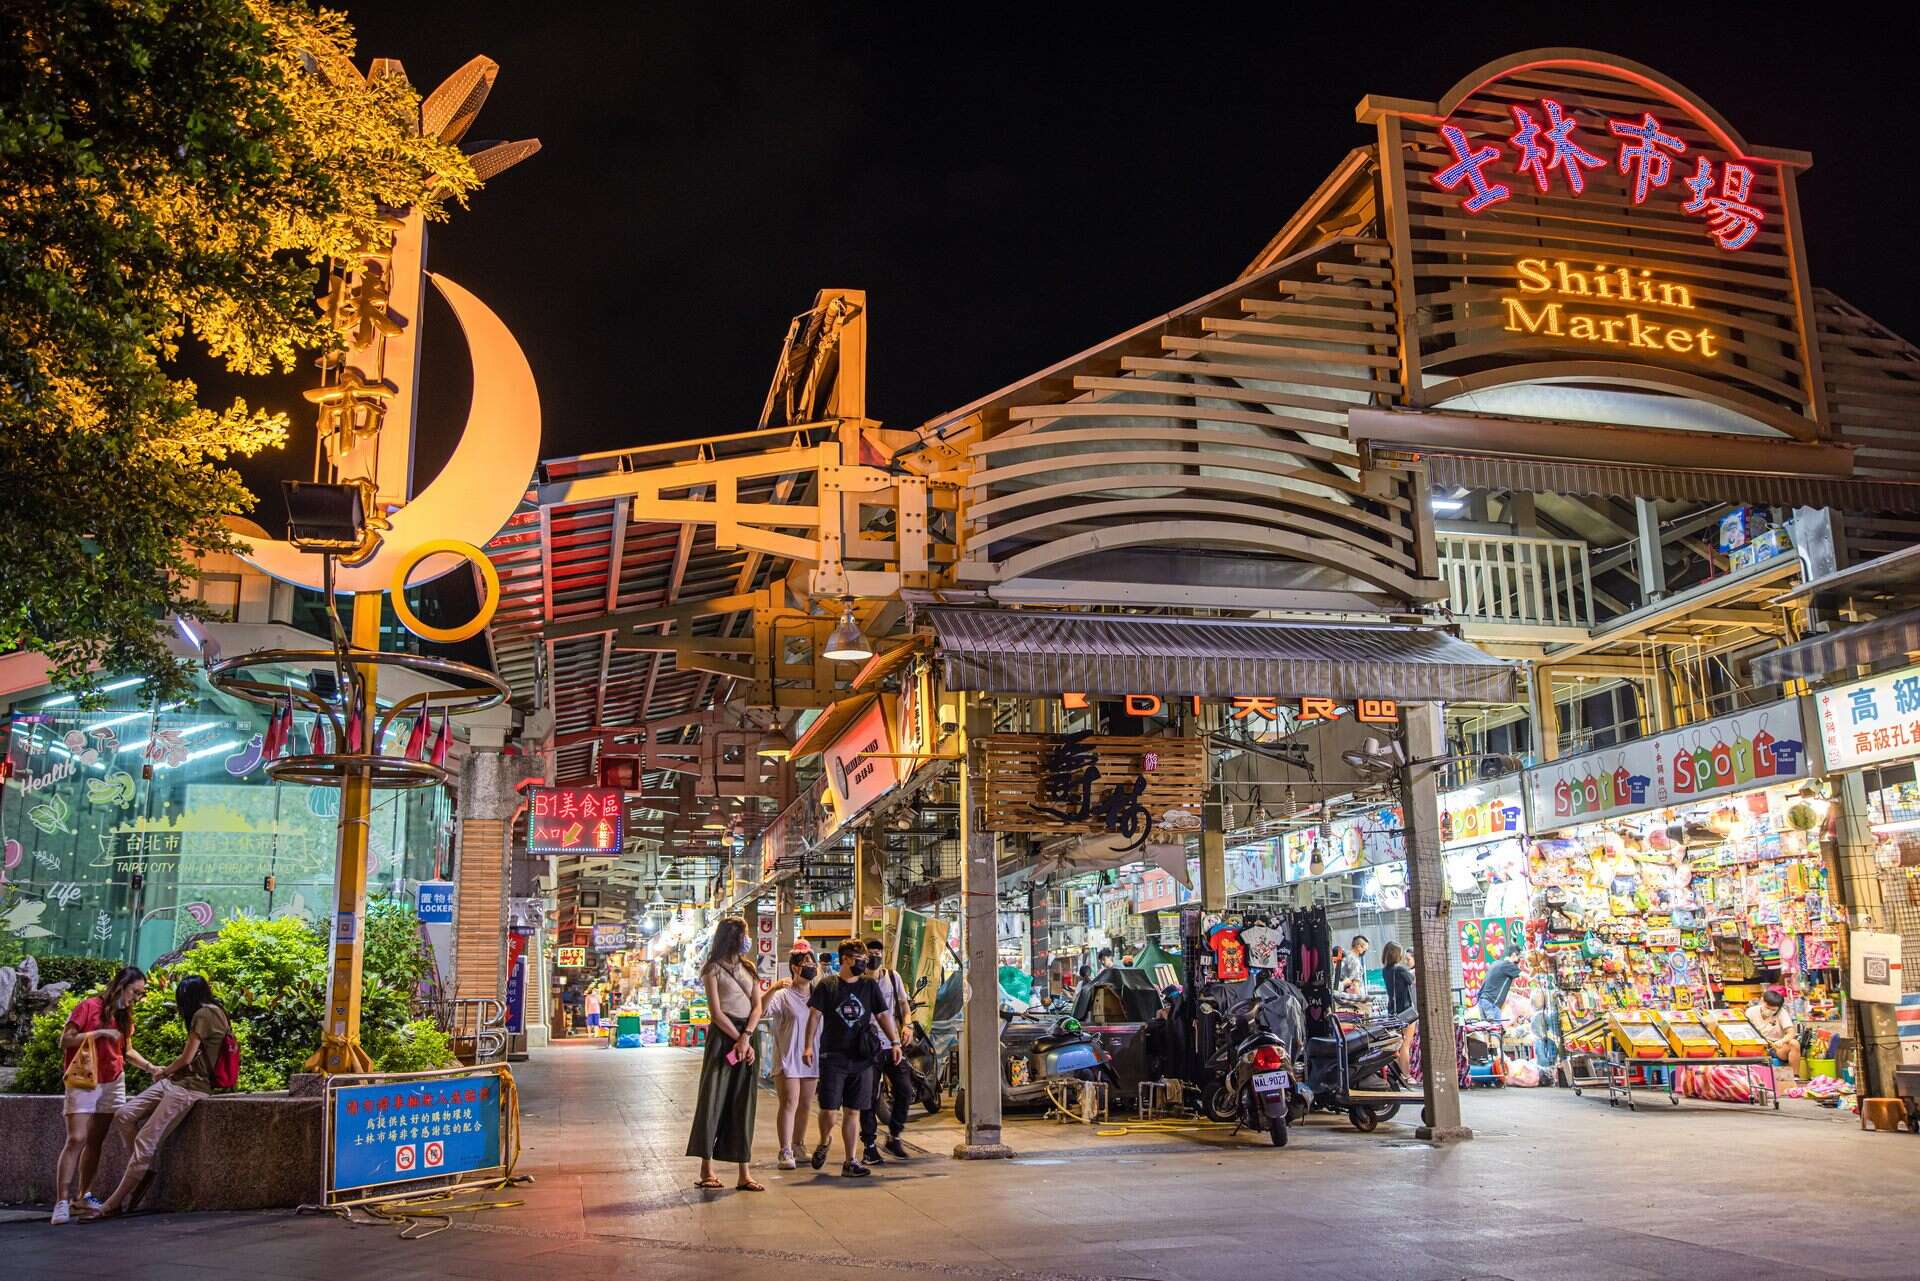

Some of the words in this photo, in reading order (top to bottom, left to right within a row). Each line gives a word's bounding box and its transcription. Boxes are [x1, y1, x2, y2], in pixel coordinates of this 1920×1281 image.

[1431, 98, 1766, 252] 士林市場
[1515, 258, 1697, 310] Shilin
[1502, 296, 1719, 358] Market
[20, 759, 77, 797] Health
[1676, 742, 1770, 791] Sport
[535, 793, 619, 818] B1美食區
[1557, 775, 1628, 815] Sport
[534, 825, 560, 840] 入口
[117, 861, 147, 874] TAIPEI
[150, 861, 175, 874] CITY
[47, 880, 82, 905] Life
